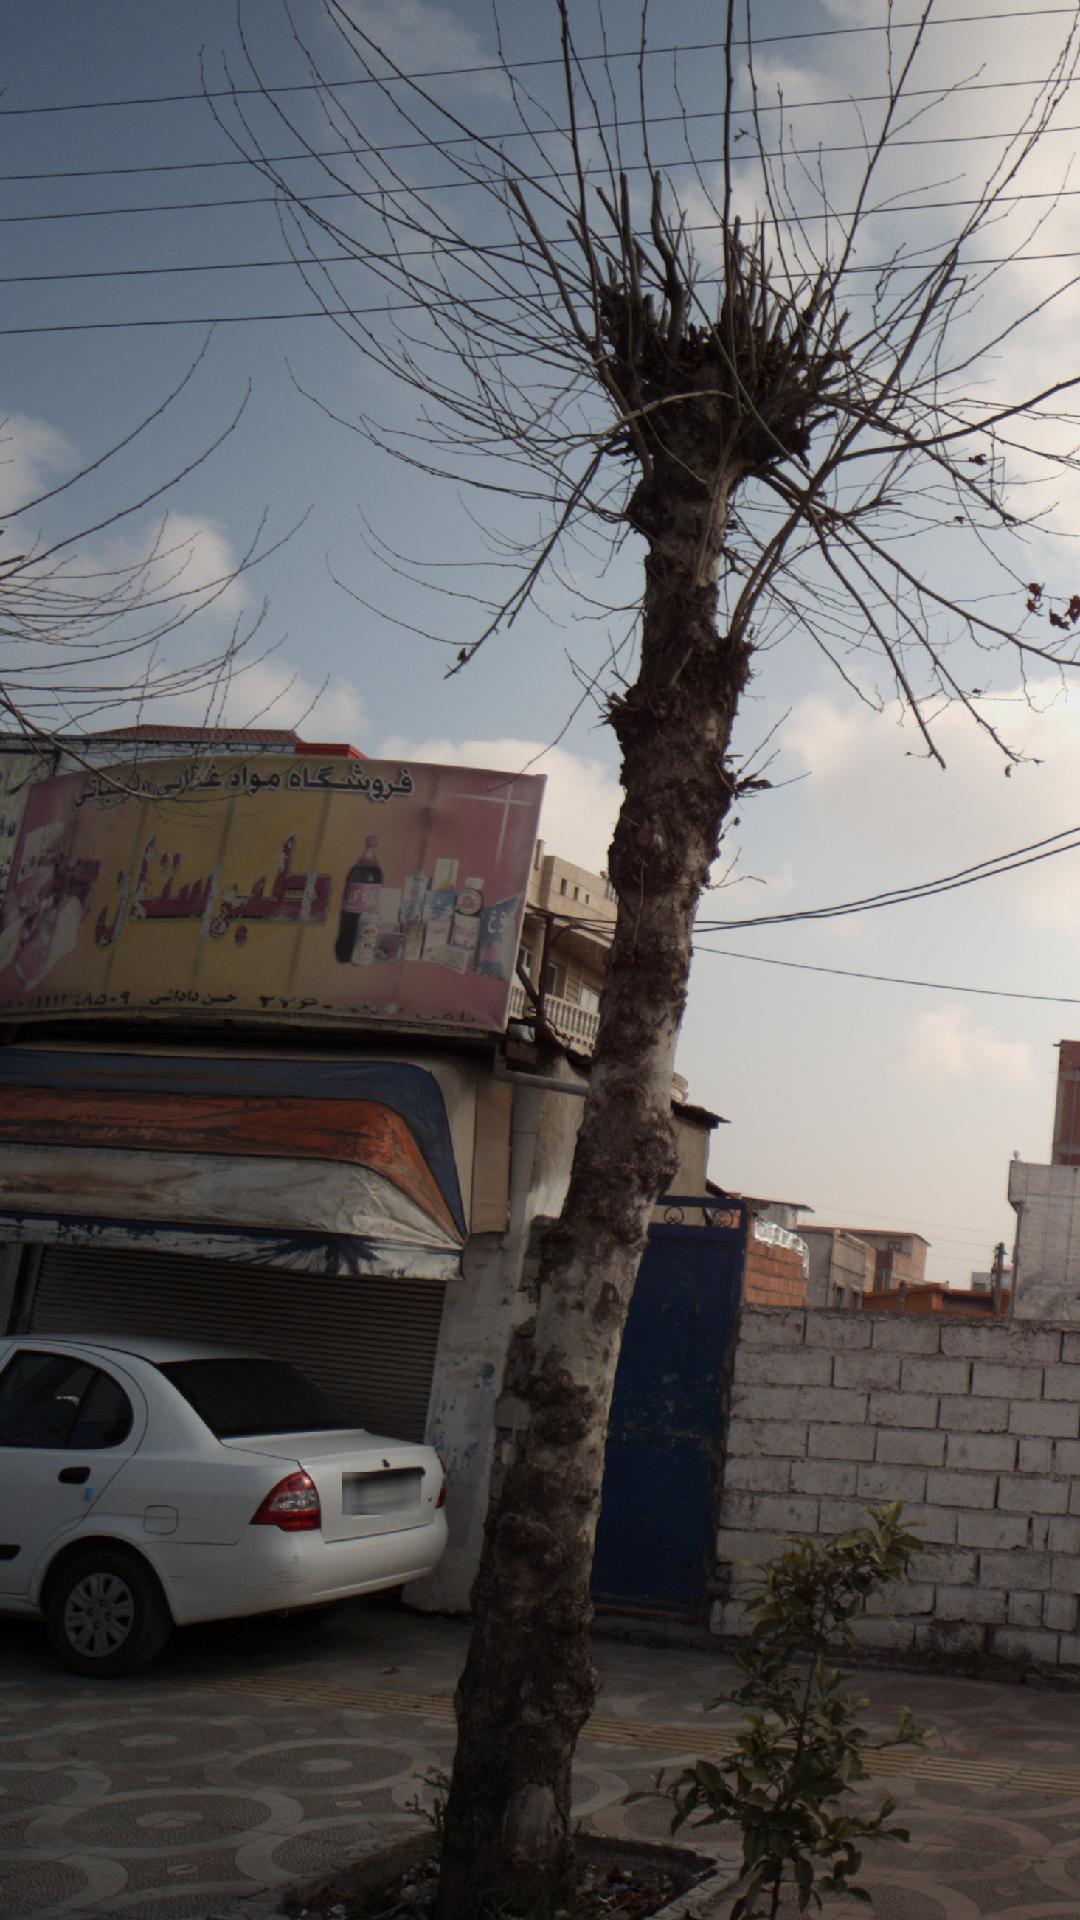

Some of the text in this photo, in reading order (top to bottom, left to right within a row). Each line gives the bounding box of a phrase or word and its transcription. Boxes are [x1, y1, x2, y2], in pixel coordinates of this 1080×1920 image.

[229, 765, 281, 794] مواد
[288, 763, 413, 800] فروشگاه
[95, 833, 332, 946] طبرستان
